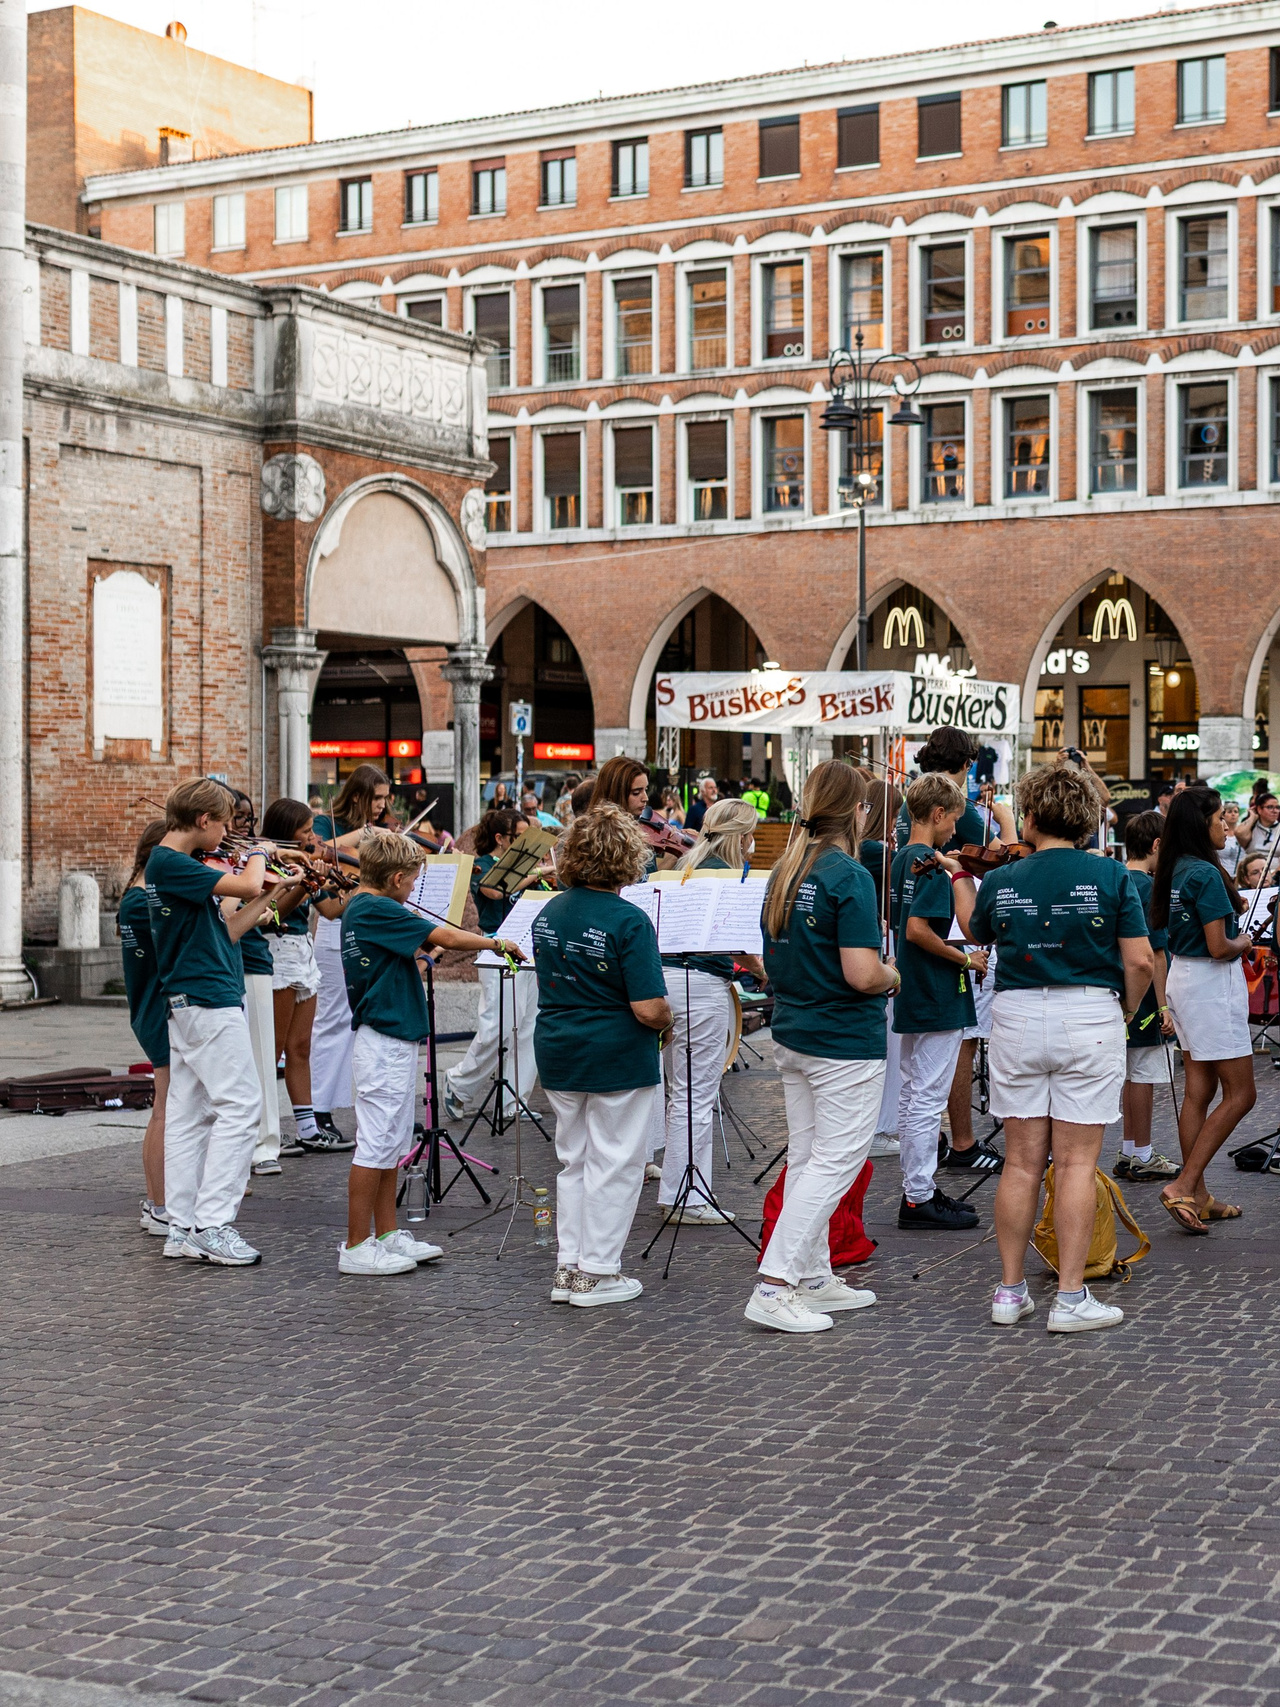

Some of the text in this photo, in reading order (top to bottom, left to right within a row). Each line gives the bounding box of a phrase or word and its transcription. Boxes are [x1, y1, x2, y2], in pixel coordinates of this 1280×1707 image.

[818, 685, 895, 722] Busk
[997, 887, 1014, 895] SCUOLA
[589, 928, 607, 937] SCUOLA
